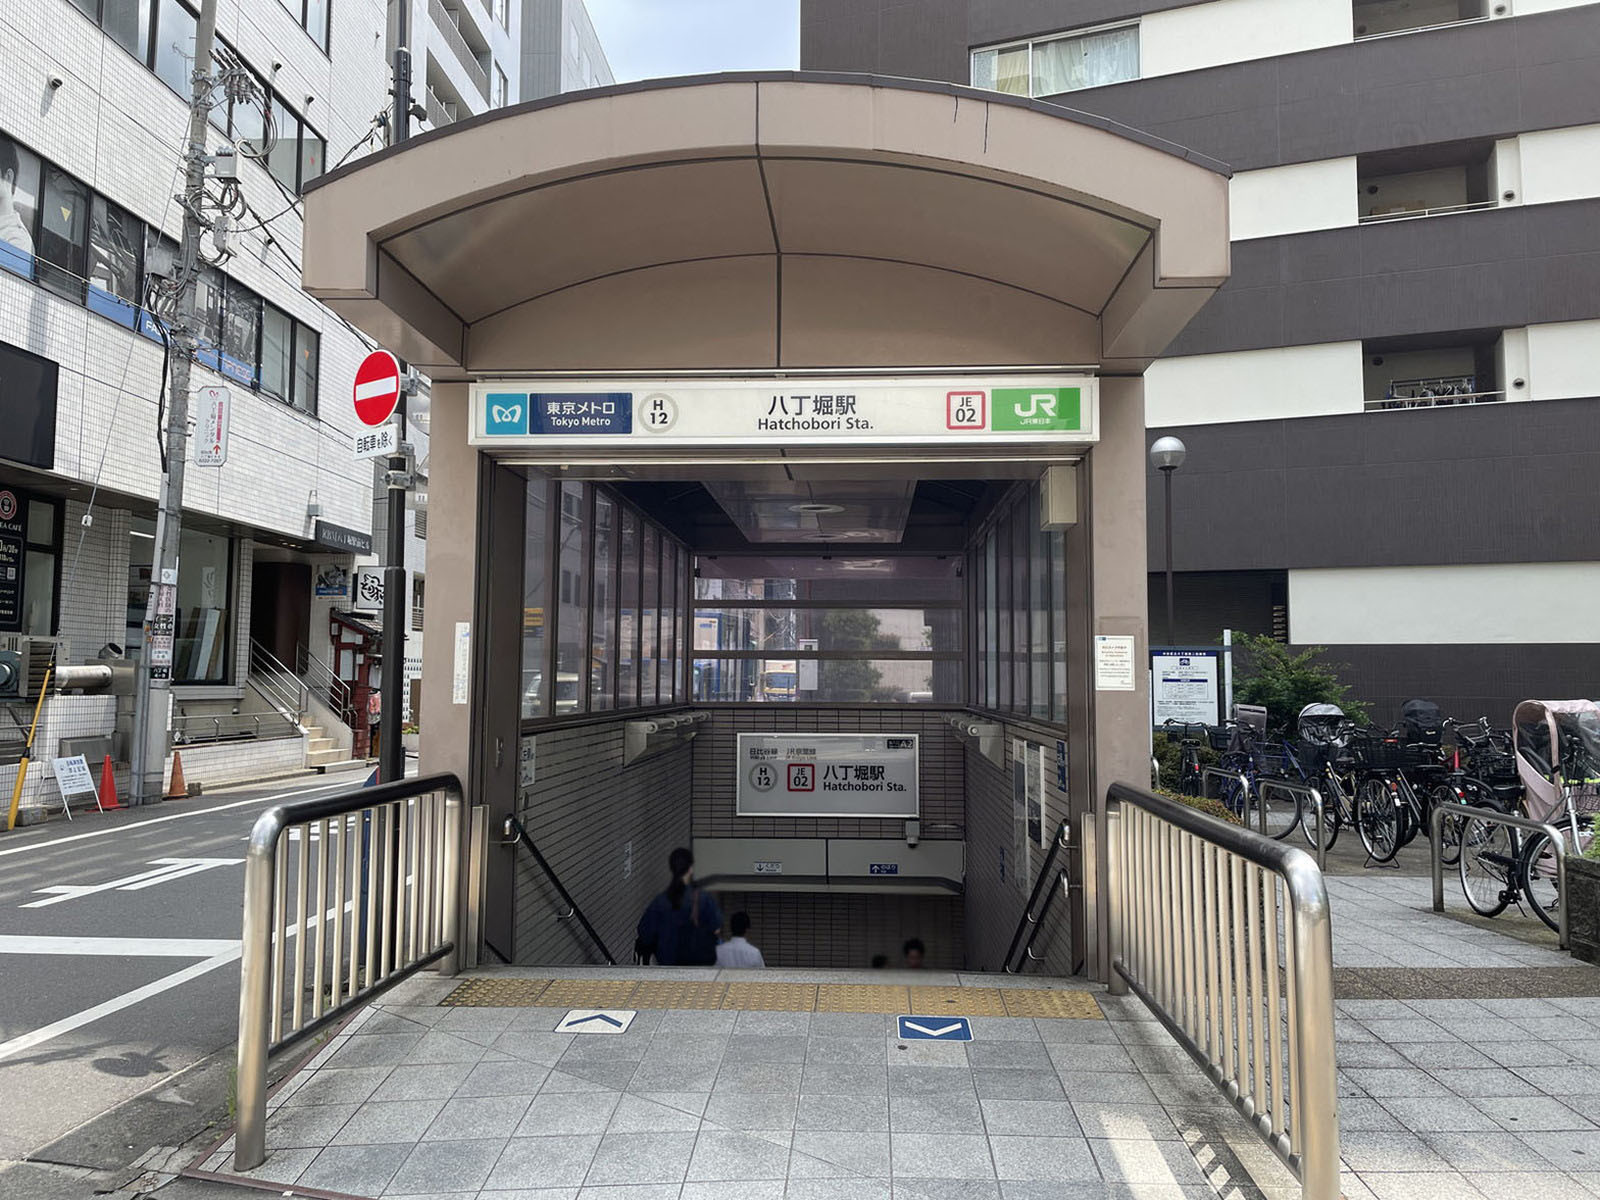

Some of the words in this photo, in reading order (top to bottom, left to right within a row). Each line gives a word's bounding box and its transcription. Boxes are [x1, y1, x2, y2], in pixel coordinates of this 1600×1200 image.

[653, 400, 664, 411] H
[768, 395, 857, 416] 八丁堀駅
[959, 396, 973, 407] JE
[1014, 393, 1057, 417] JR
[547, 402, 615, 415] 東京メトロ
[650, 412, 668, 425] 12
[955, 408, 977, 423] 02
[551, 416, 579, 428] Tokyo
[581, 416, 612, 427] Metro
[758, 417, 841, 430] Hatchobori
[846, 417, 874, 430] Sta.
[759, 767, 768, 776] H
[796, 768, 806, 776] JE
[823, 765, 885, 781] 八丁堀駅
[757, 776, 770, 786] 12
[793, 776, 808, 787] 02
[823, 781, 883, 792] Hatchobori
[887, 782, 907, 792] Sta.
